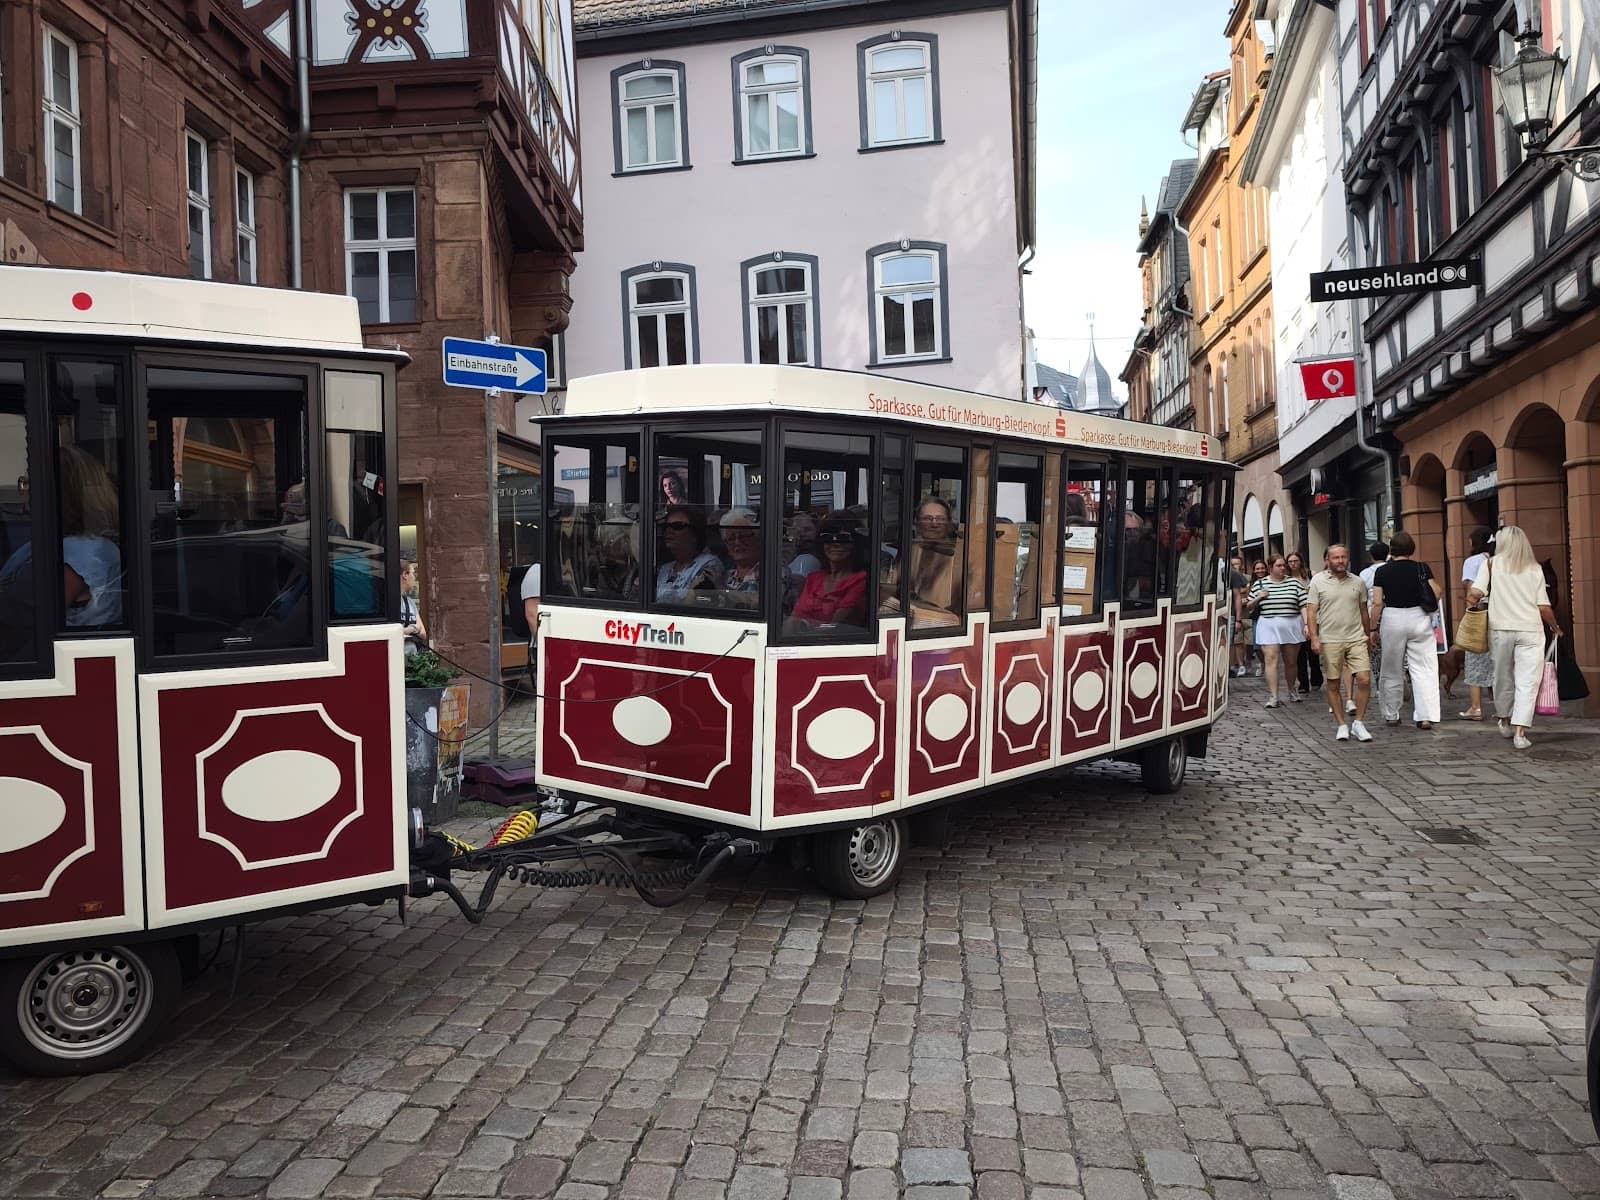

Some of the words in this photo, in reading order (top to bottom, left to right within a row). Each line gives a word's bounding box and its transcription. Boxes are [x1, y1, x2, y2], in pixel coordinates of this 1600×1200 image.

[1324, 267, 1438, 294] neusehland
[450, 356, 518, 374] Einbahnstraße
[868, 392, 926, 417] Sparkasse.
[928, 403, 946, 421] Gut
[948, 405, 962, 424] für
[1118, 433, 1129, 447] Gut
[1130, 434, 1139, 448] für
[604, 619, 685, 645] CityTrain
